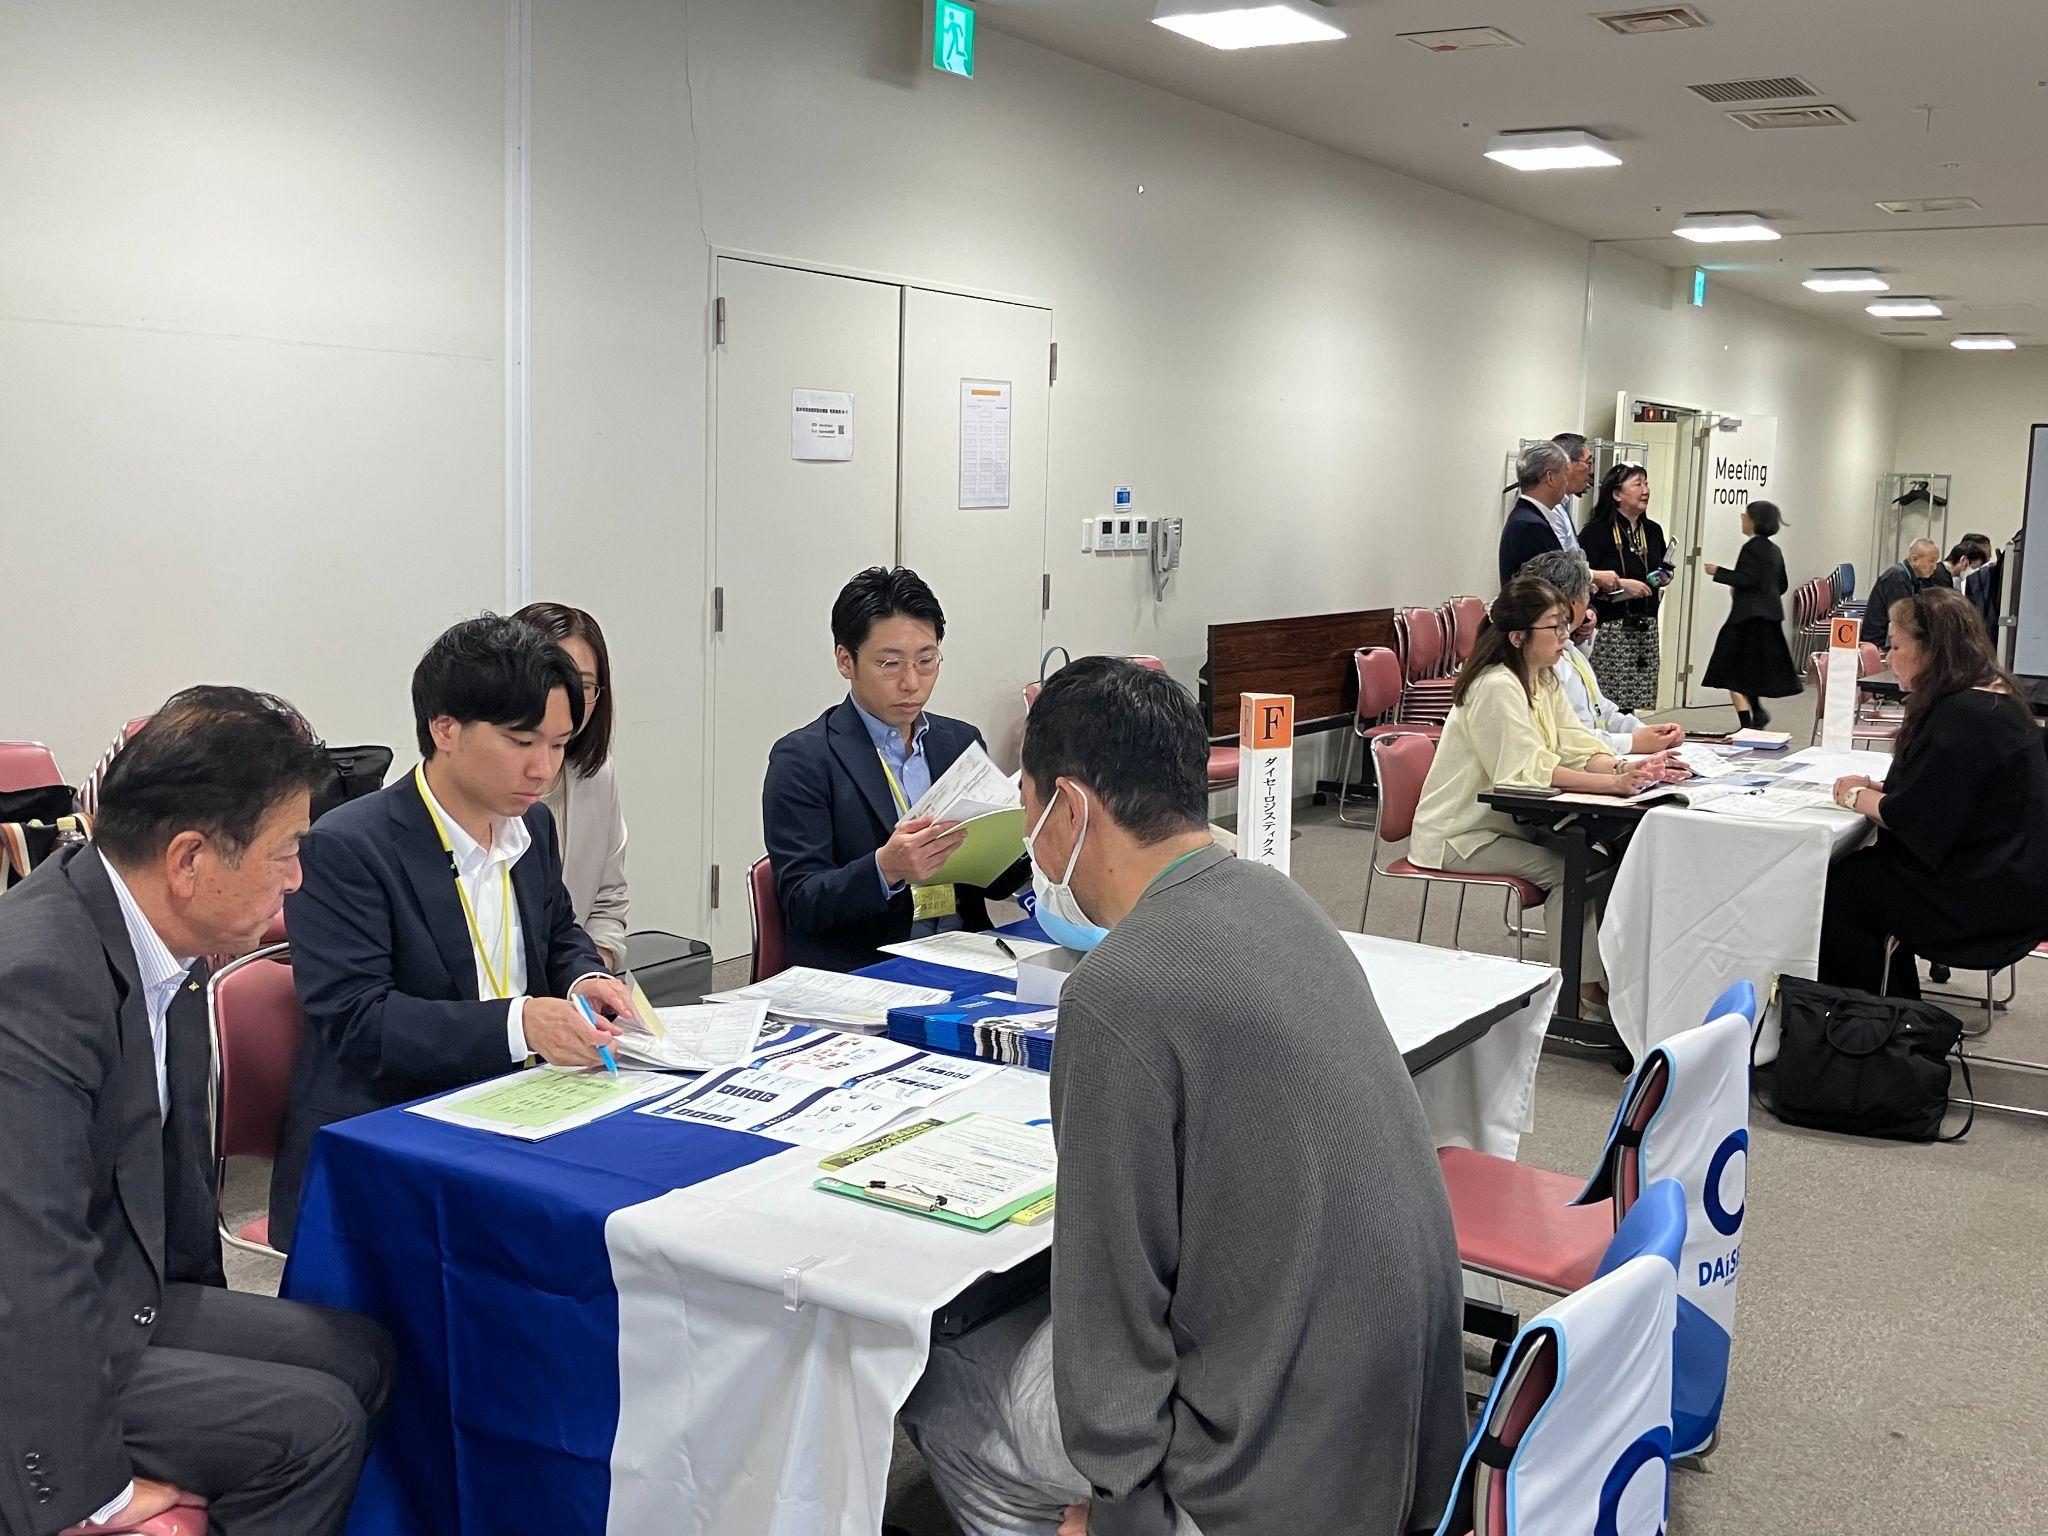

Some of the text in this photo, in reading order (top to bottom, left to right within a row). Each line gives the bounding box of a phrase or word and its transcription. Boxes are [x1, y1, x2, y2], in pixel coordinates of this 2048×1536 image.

[1715, 457, 1768, 487] Meeting
[1713, 488, 1748, 505] room
[1837, 624, 1853, 644] C
[1262, 706, 1285, 740] F
[1262, 756, 1278, 866] ダイセーロジスティクス
